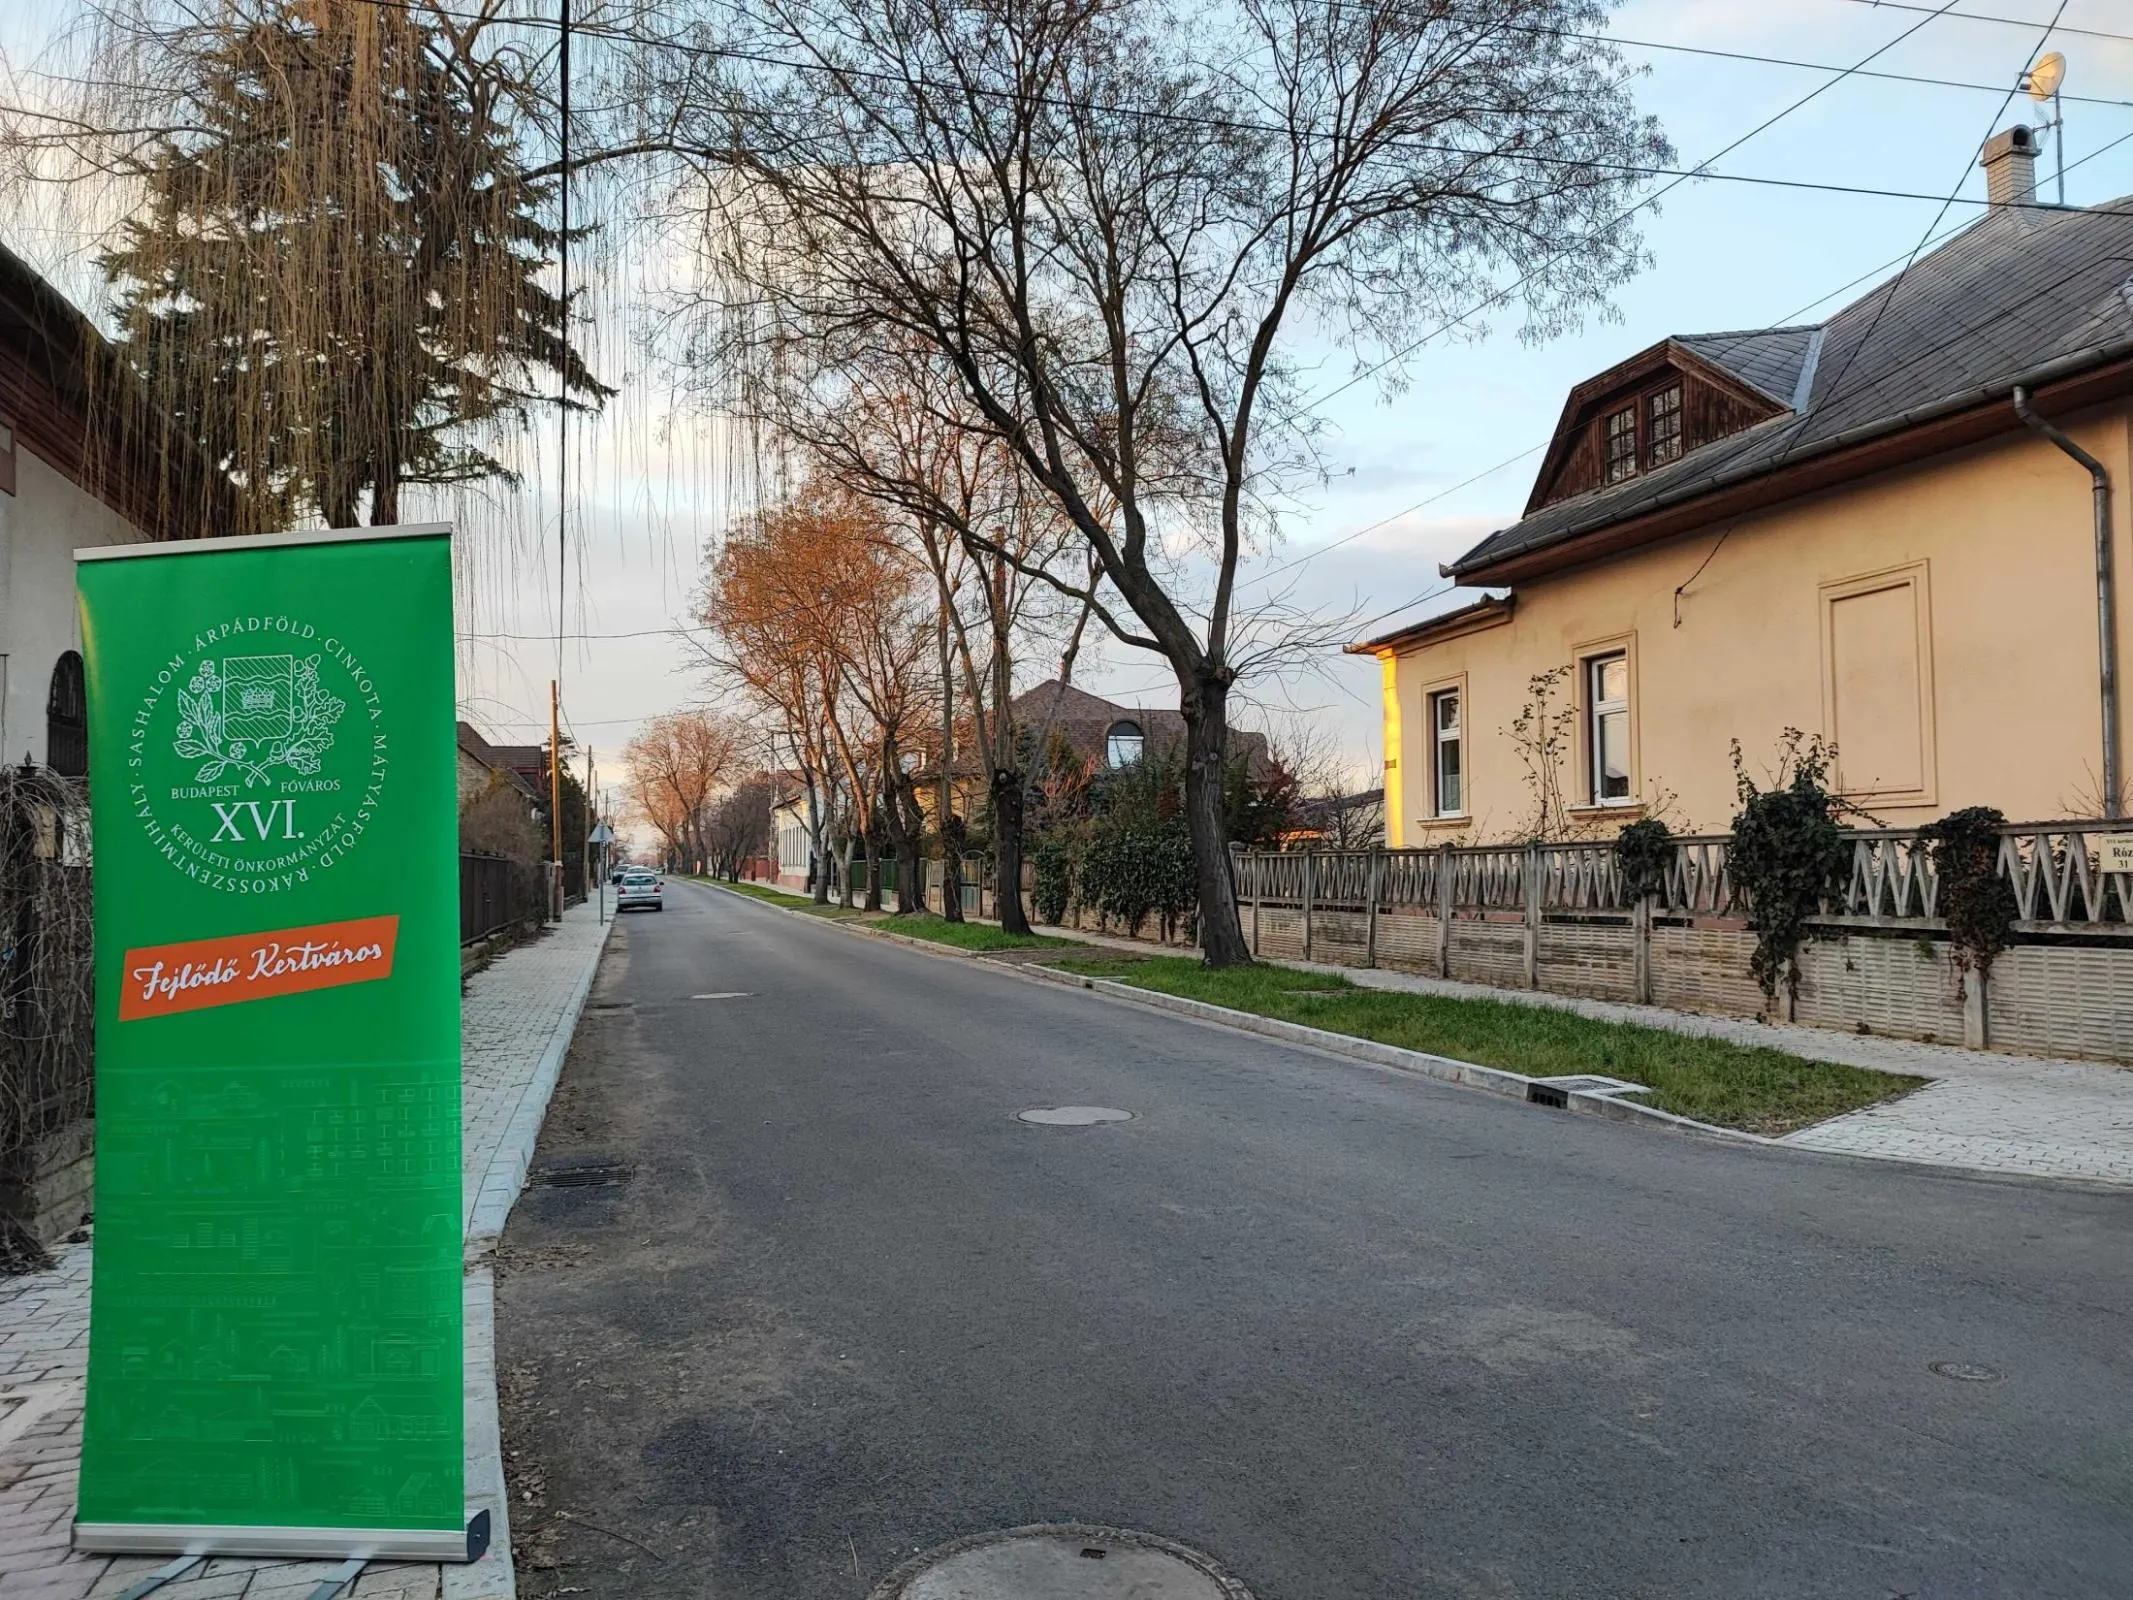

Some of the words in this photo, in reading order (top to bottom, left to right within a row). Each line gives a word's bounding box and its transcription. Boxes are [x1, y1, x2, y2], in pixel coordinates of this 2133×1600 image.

[194, 615, 315, 652] ÁRPÁDFÖLD
[128, 653, 186, 767] SASHALOM
[324, 638, 383, 721] CINKOTA
[171, 784, 240, 800] BUDAPEST
[210, 799, 305, 843] XVI.
[319, 734, 388, 869] MÁTYÁSFÖLD
[130, 782, 310, 894] RÁKOSSZENTMIHÁLY
[170, 823, 231, 870] KERÜLETI
[233, 811, 348, 873] ÖNKORMÁNYZAT
[133, 957, 241, 1001] Fejlődő
[246, 939, 383, 982] Kertváros
